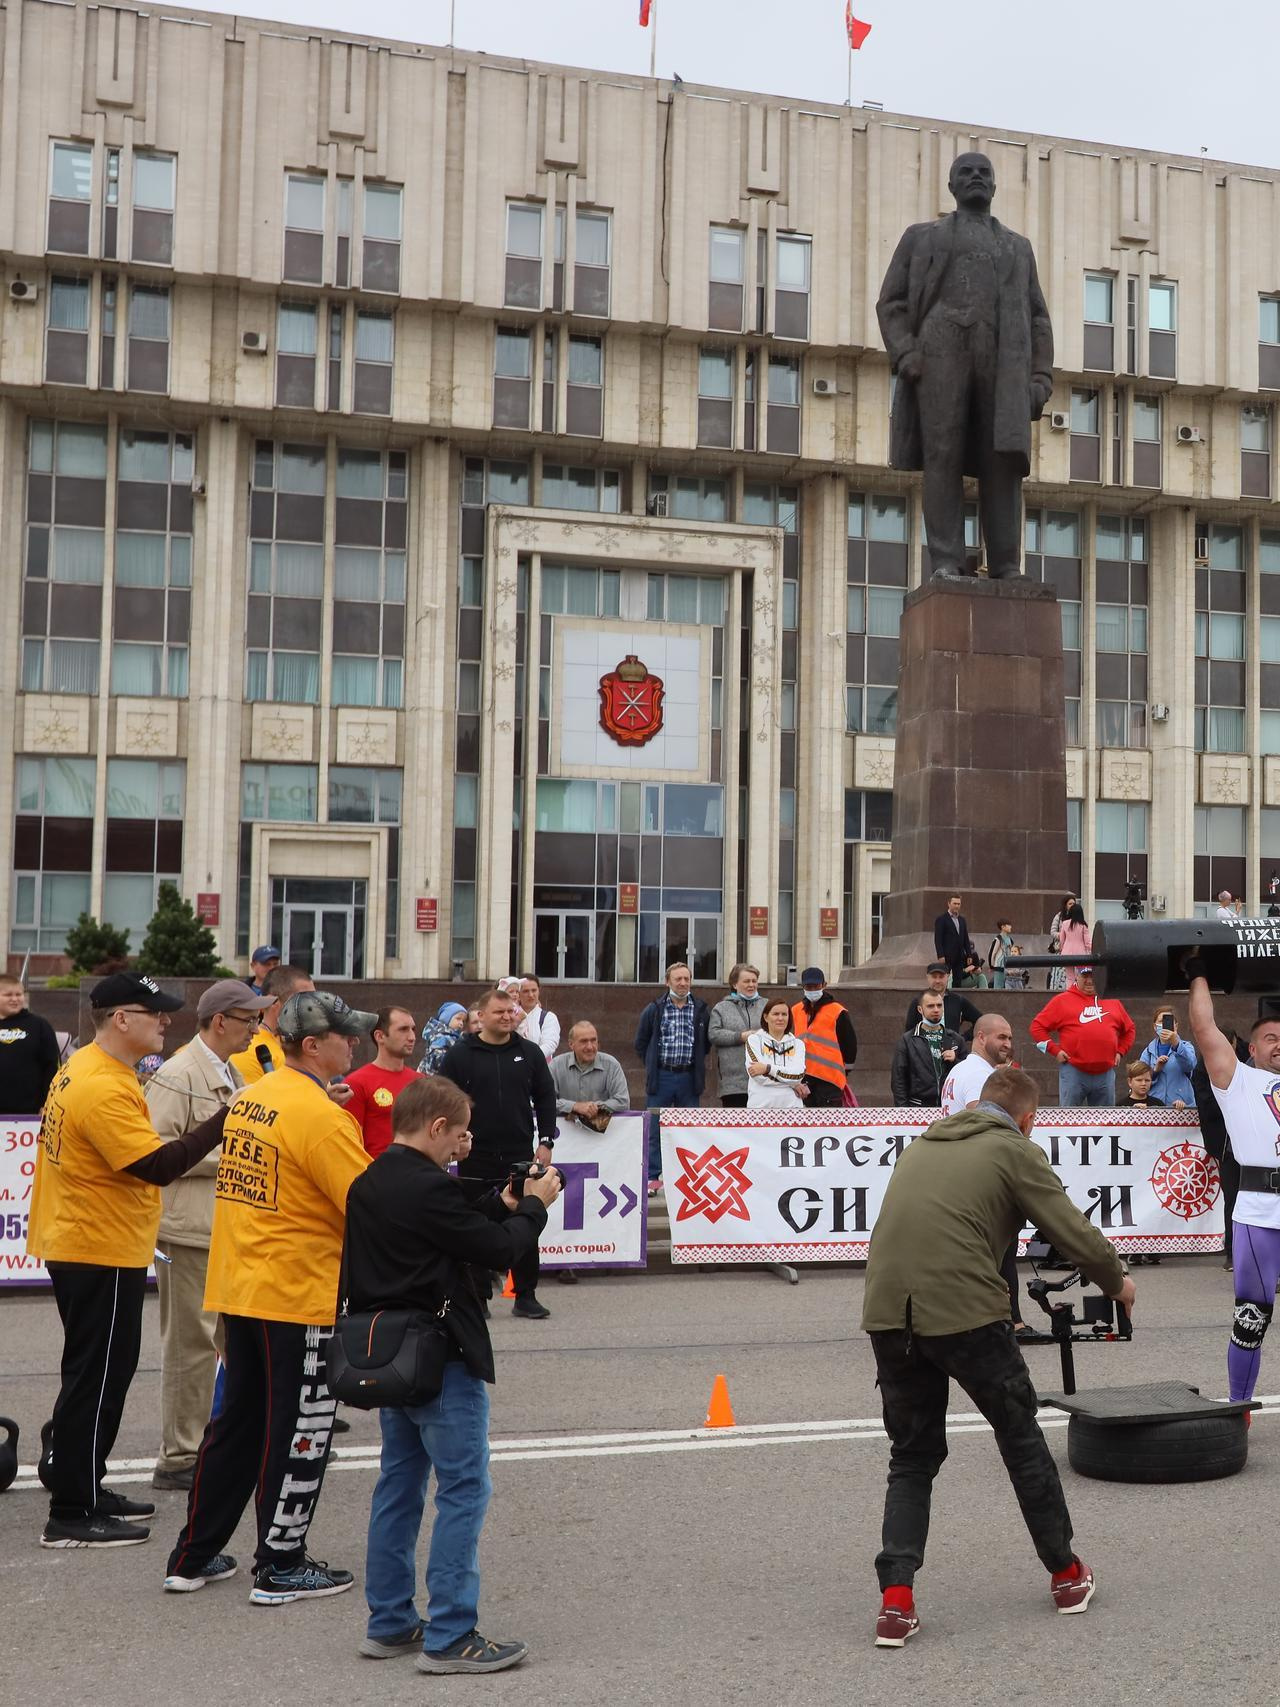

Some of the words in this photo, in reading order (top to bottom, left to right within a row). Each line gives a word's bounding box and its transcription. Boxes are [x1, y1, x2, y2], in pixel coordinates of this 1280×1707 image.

[231, 1100, 279, 1127] СУДЬЯ
[574, 1243, 616, 1254] торца)
[289, 1384, 337, 1460] BIG
[265, 1473, 320, 1551] GET
